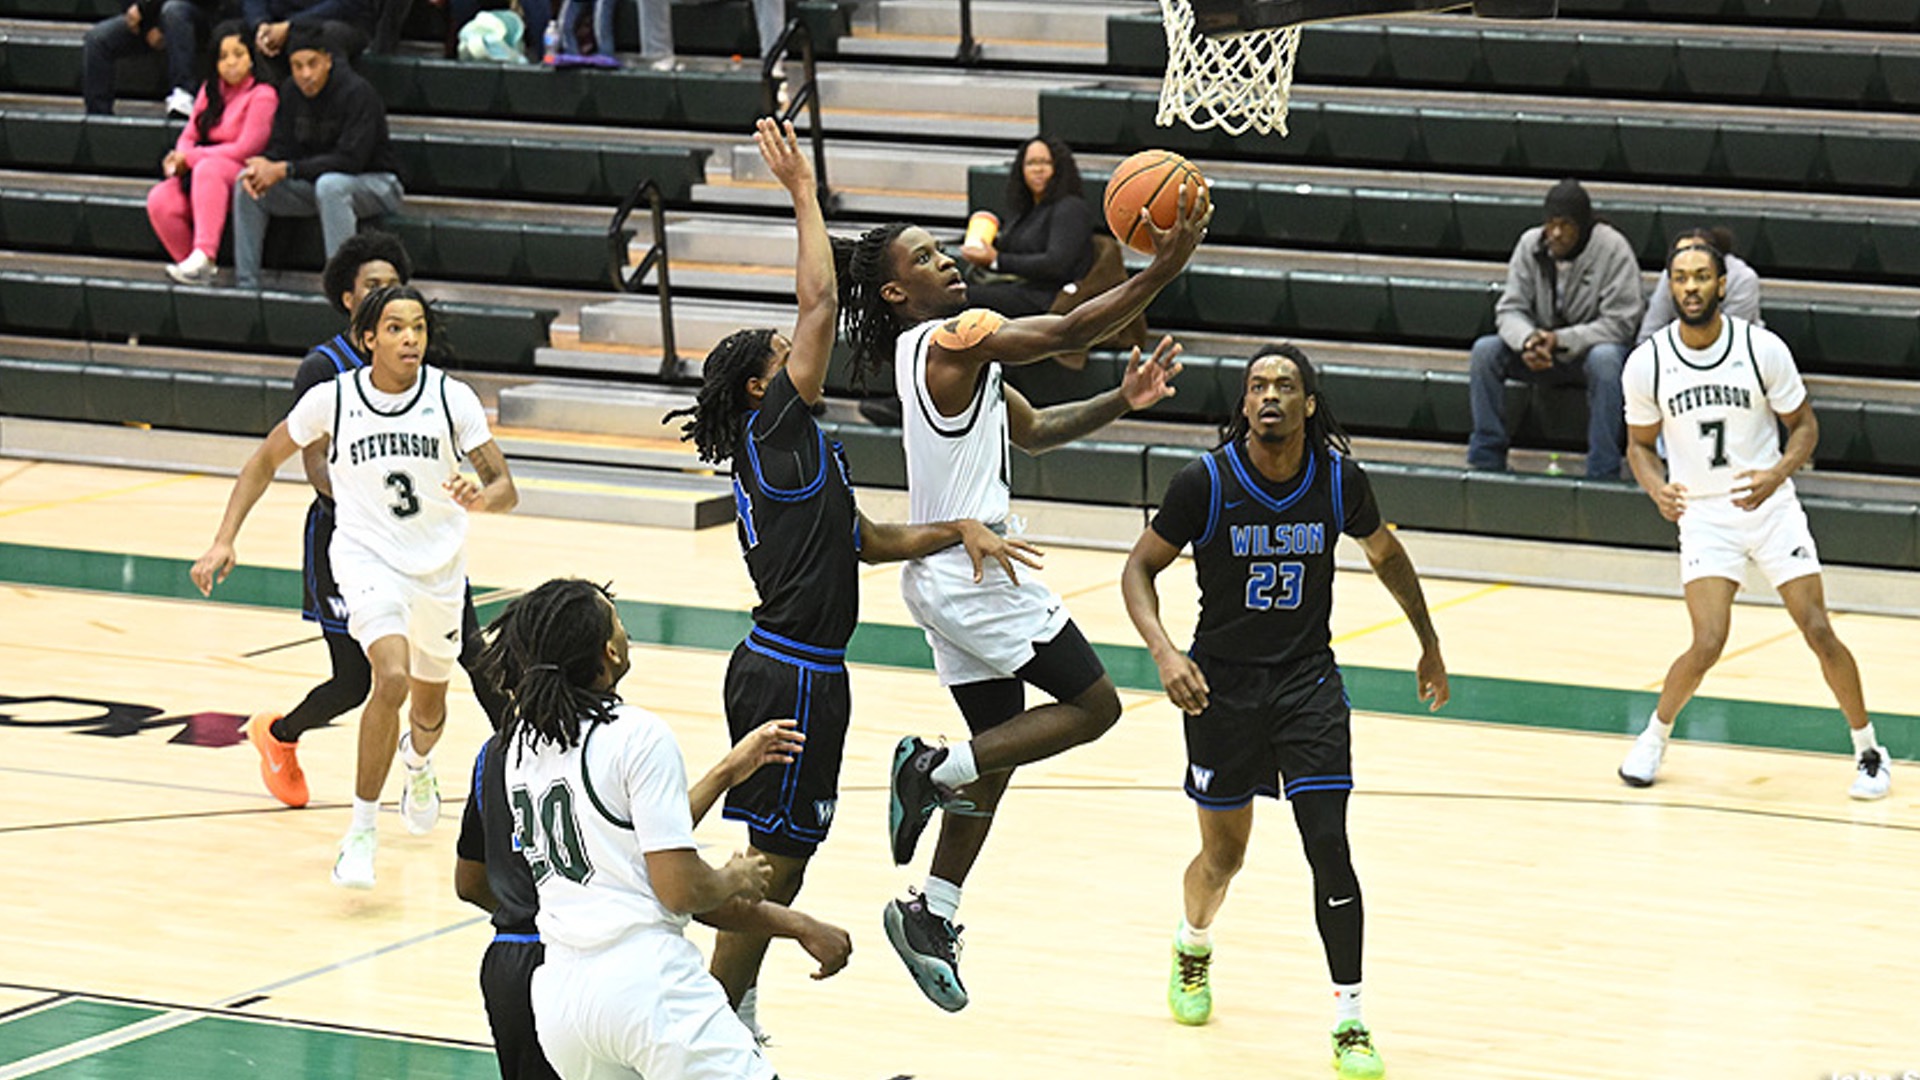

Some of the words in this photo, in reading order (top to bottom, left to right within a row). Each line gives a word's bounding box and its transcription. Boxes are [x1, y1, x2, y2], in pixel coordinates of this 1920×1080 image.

[1668, 385, 1751, 417] STEVENSON
[350, 432, 440, 465] STEVENSON
[1698, 418, 1730, 470] 7
[385, 471, 421, 518] 3
[1230, 523, 1324, 556] WILSON
[1245, 562, 1305, 610] 23
[1190, 763, 1215, 793] W
